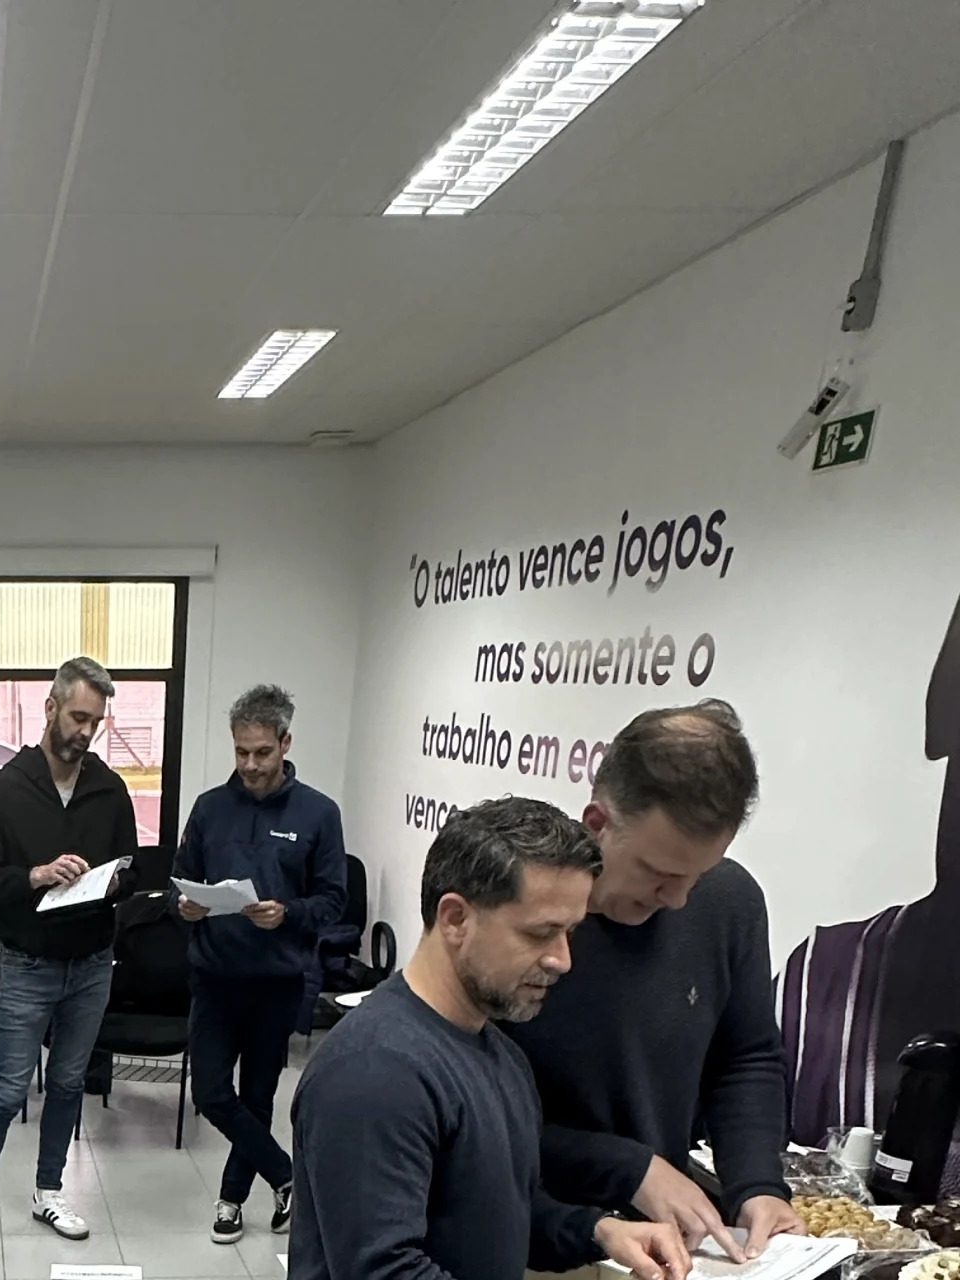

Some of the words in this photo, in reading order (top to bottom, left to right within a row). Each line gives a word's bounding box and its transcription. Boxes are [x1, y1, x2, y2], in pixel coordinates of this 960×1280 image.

[434, 549, 511, 605] talento
[519, 534, 605, 592] vence
[608, 508, 735, 597] jogos,
[474, 639, 527, 683] mas
[530, 625, 676, 687] somente
[687, 632, 716, 688] o
[422, 712, 512, 770] trabalho
[517, 735, 560, 779] em
